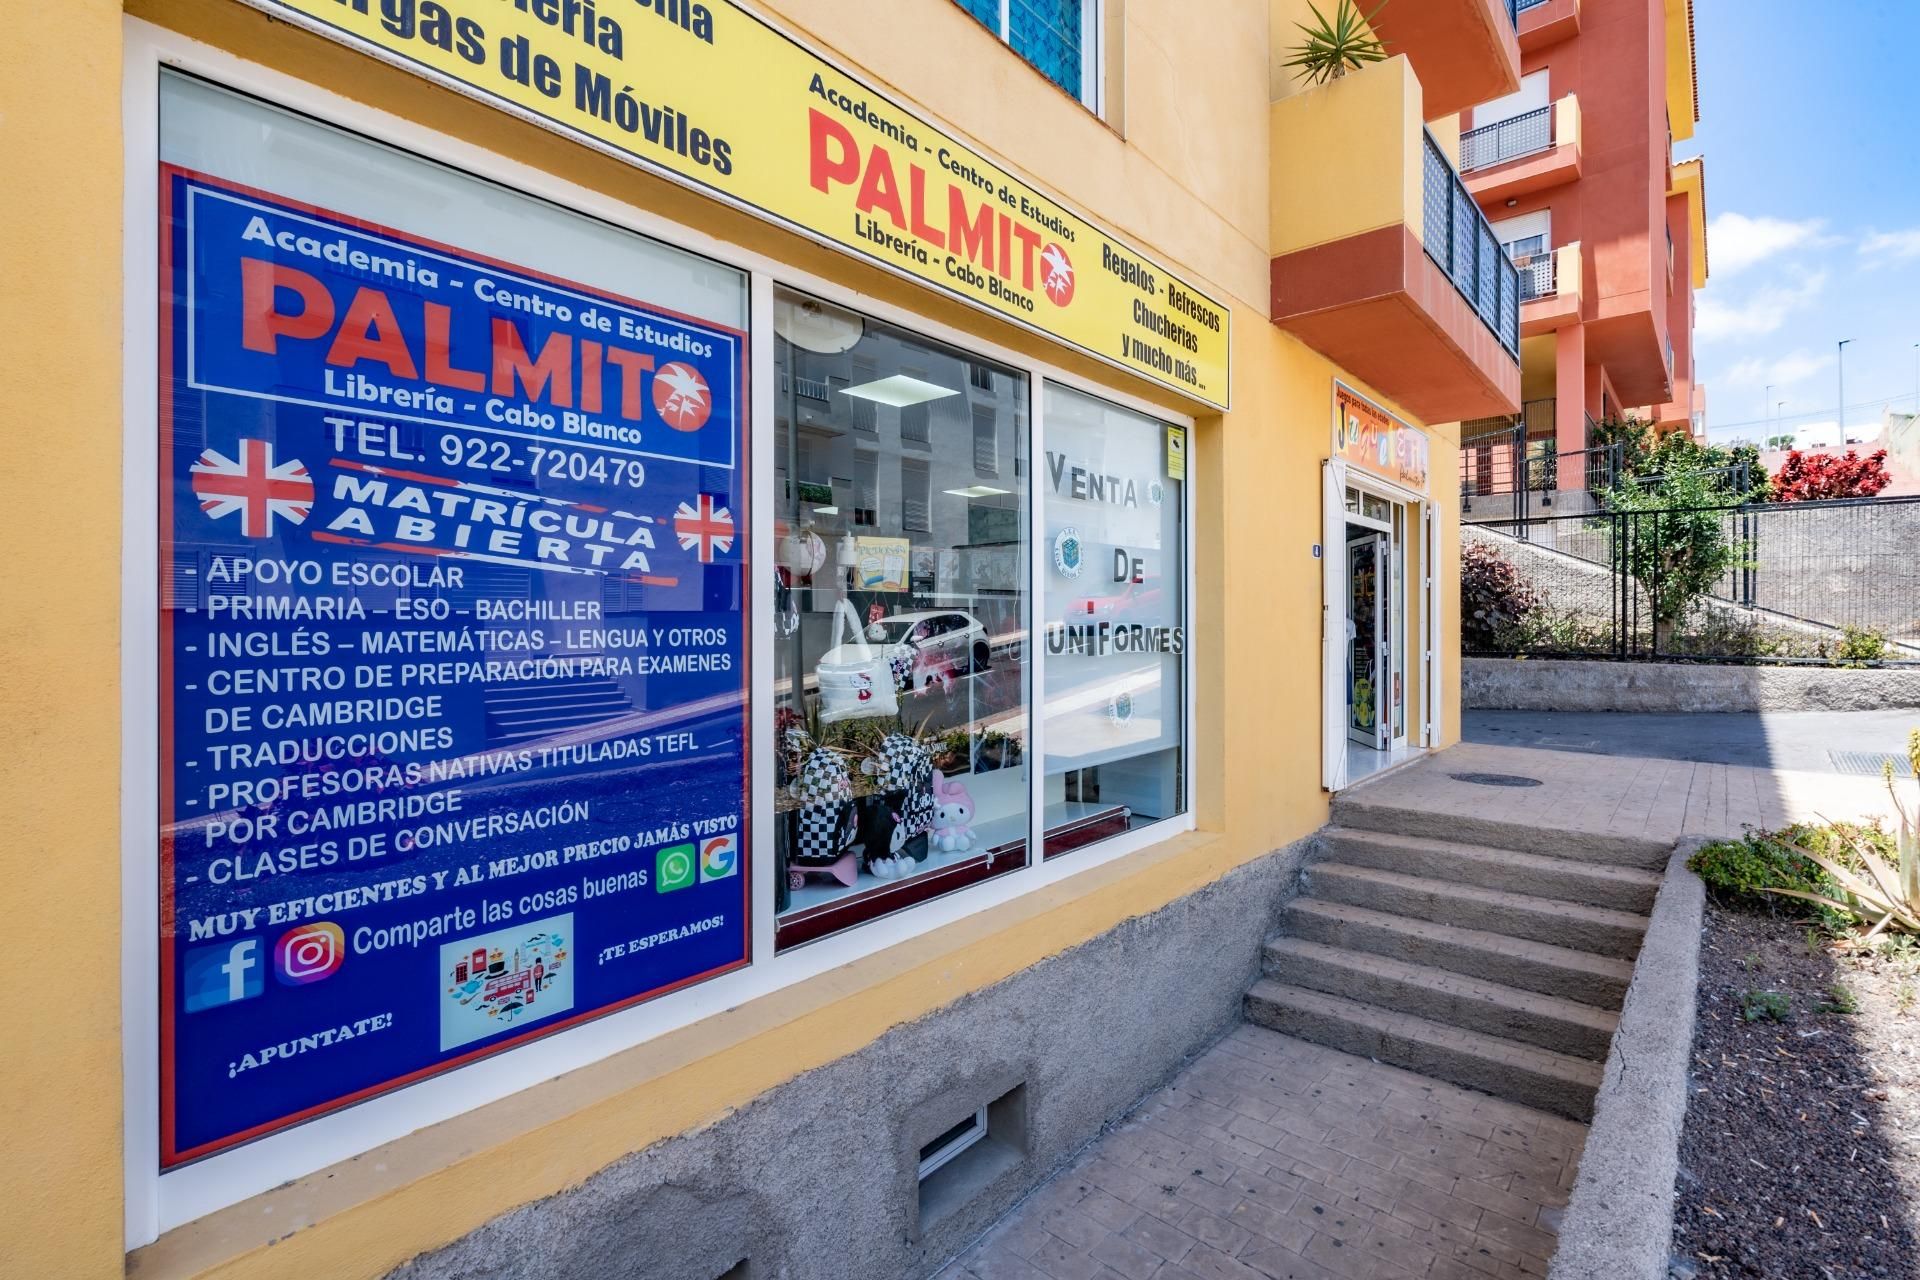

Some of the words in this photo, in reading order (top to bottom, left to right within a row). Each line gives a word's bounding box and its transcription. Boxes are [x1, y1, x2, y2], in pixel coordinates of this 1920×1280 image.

[500, 34, 561, 98] de
[575, 62, 732, 176] Móviles
[809, 72, 918, 153] Academia
[938, 148, 994, 194] Centro
[998, 183, 1017, 208] de
[1021, 198, 1075, 243] Estudios
[241, 215, 438, 288] Academia
[474, 278, 572, 322] Centro
[580, 308, 612, 333] de
[619, 316, 712, 358] Estudios
[855, 213, 928, 265] Librería
[945, 256, 985, 289] Cabo
[989, 278, 1034, 312] Blanco
[1102, 242, 1155, 295] Regalos
[1168, 282, 1220, 332] Refrescos
[1122, 333, 1130, 357] y
[1132, 338, 1173, 375] mucho
[1133, 298, 1198, 353] Chucherias
[324, 369, 454, 415] Librería
[485, 398, 556, 431] Cabo
[563, 411, 642, 444] Blanco
[323, 416, 426, 463] TEL.
[440, 434, 645, 488] 922-720479
[1045, 450, 1138, 509] VENTA
[326, 507, 650, 573] ABIERTA
[333, 474, 655, 549] MATRÍCULA
[206, 557, 322, 584] APOYO
[332, 561, 464, 589] ESCOLAR
[1113, 548, 1144, 583] DE
[207, 595, 366, 621] PRIMARIA
[395, 598, 450, 621] ESO
[476, 599, 601, 621] BACHILLER
[207, 626, 331, 658] INGLÉS
[361, 626, 544, 654] MATEMÁTICAS
[566, 628, 648, 650] LENGUA
[653, 628, 665, 647] Y
[668, 628, 727, 647] OTROS
[207, 666, 346, 696] CENTRO
[355, 664, 393, 688] DE
[401, 654, 574, 686] PREPARACIÓN
[580, 656, 633, 678] PARA
[638, 653, 732, 675] EXAMENES
[205, 706, 252, 734] DE
[261, 695, 442, 728] CAMBRIDGE
[206, 726, 453, 771] TRADUCCIONES
[208, 762, 423, 810] PROFESORAS
[429, 750, 532, 781] NATIVAS
[538, 736, 652, 768] TITULADAS
[655, 732, 699, 754] TEFL
[205, 814, 277, 849] POR
[287, 789, 462, 835] CAMBRIDGE
[208, 841, 339, 885] CLASES
[348, 833, 387, 861] DE
[394, 799, 589, 853] CONVERSACIÓN
[188, 908, 262, 942] MUY
[268, 877, 428, 926] EFICIENTES
[431, 870, 449, 891] Y
[454, 864, 485, 887] AL
[488, 849, 559, 880] MEJOR
[563, 836, 631, 865] PRECIO
[633, 821, 690, 850] JAMÁS
[692, 813, 737, 837] VISTO
[353, 907, 476, 955] Comparte
[482, 899, 513, 924] las
[519, 883, 578, 915] cosas
[583, 869, 648, 900] buenas
[598, 945, 625, 966] ¡TE
[628, 914, 725, 953] ESPERAMOS!
[228, 1012, 393, 1079] ¡APUNTATE!
